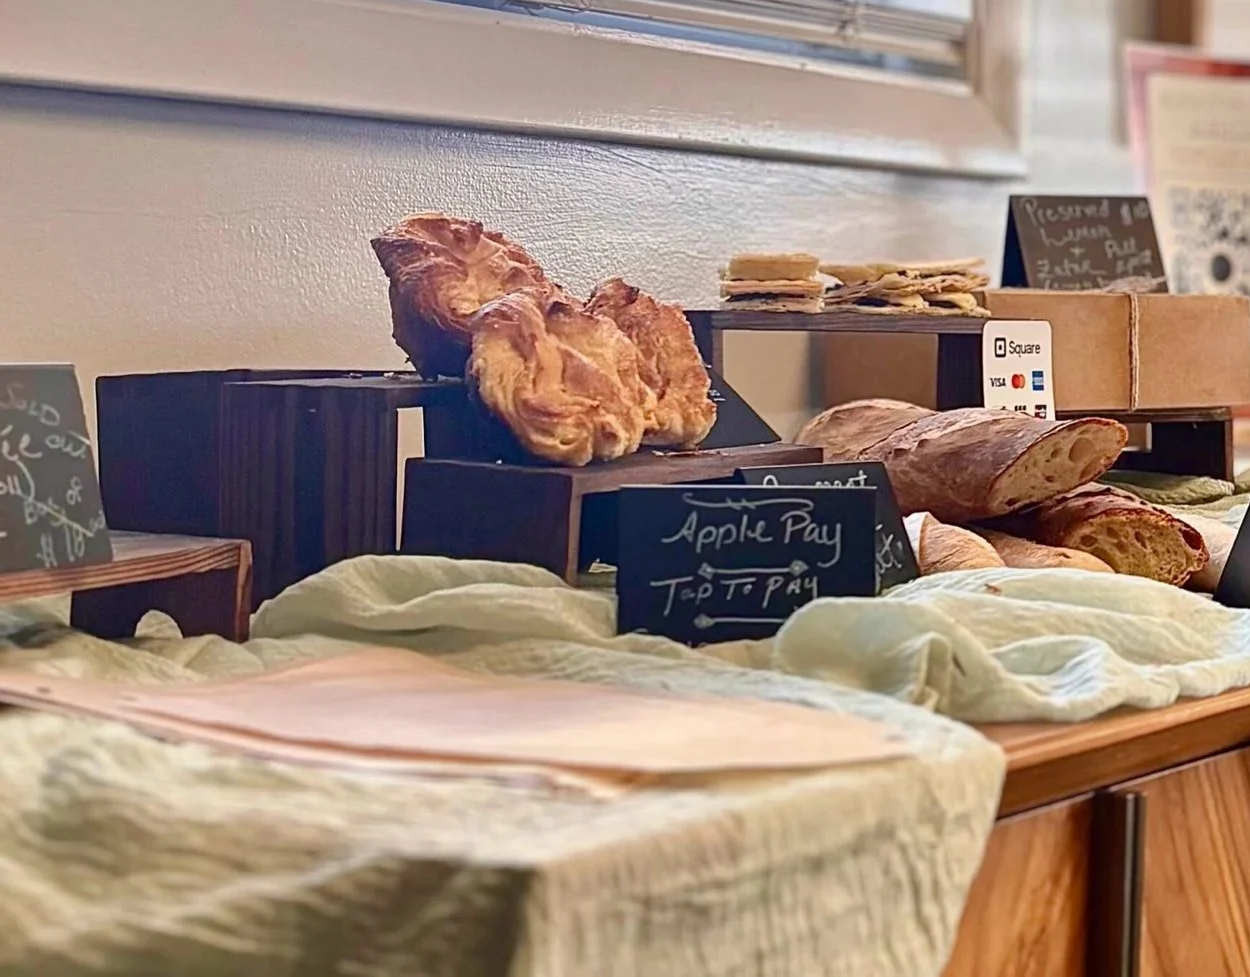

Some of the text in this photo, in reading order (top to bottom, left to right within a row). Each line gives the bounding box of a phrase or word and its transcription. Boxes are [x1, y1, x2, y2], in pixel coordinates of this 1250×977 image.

[1008, 340, 1041, 358] Square
[989, 377, 1006, 388] VISA
[661, 511, 773, 553] Apple
[780, 510, 842, 568] Pay
[650, 575, 714, 616] Tap
[719, 577, 757, 601] To
